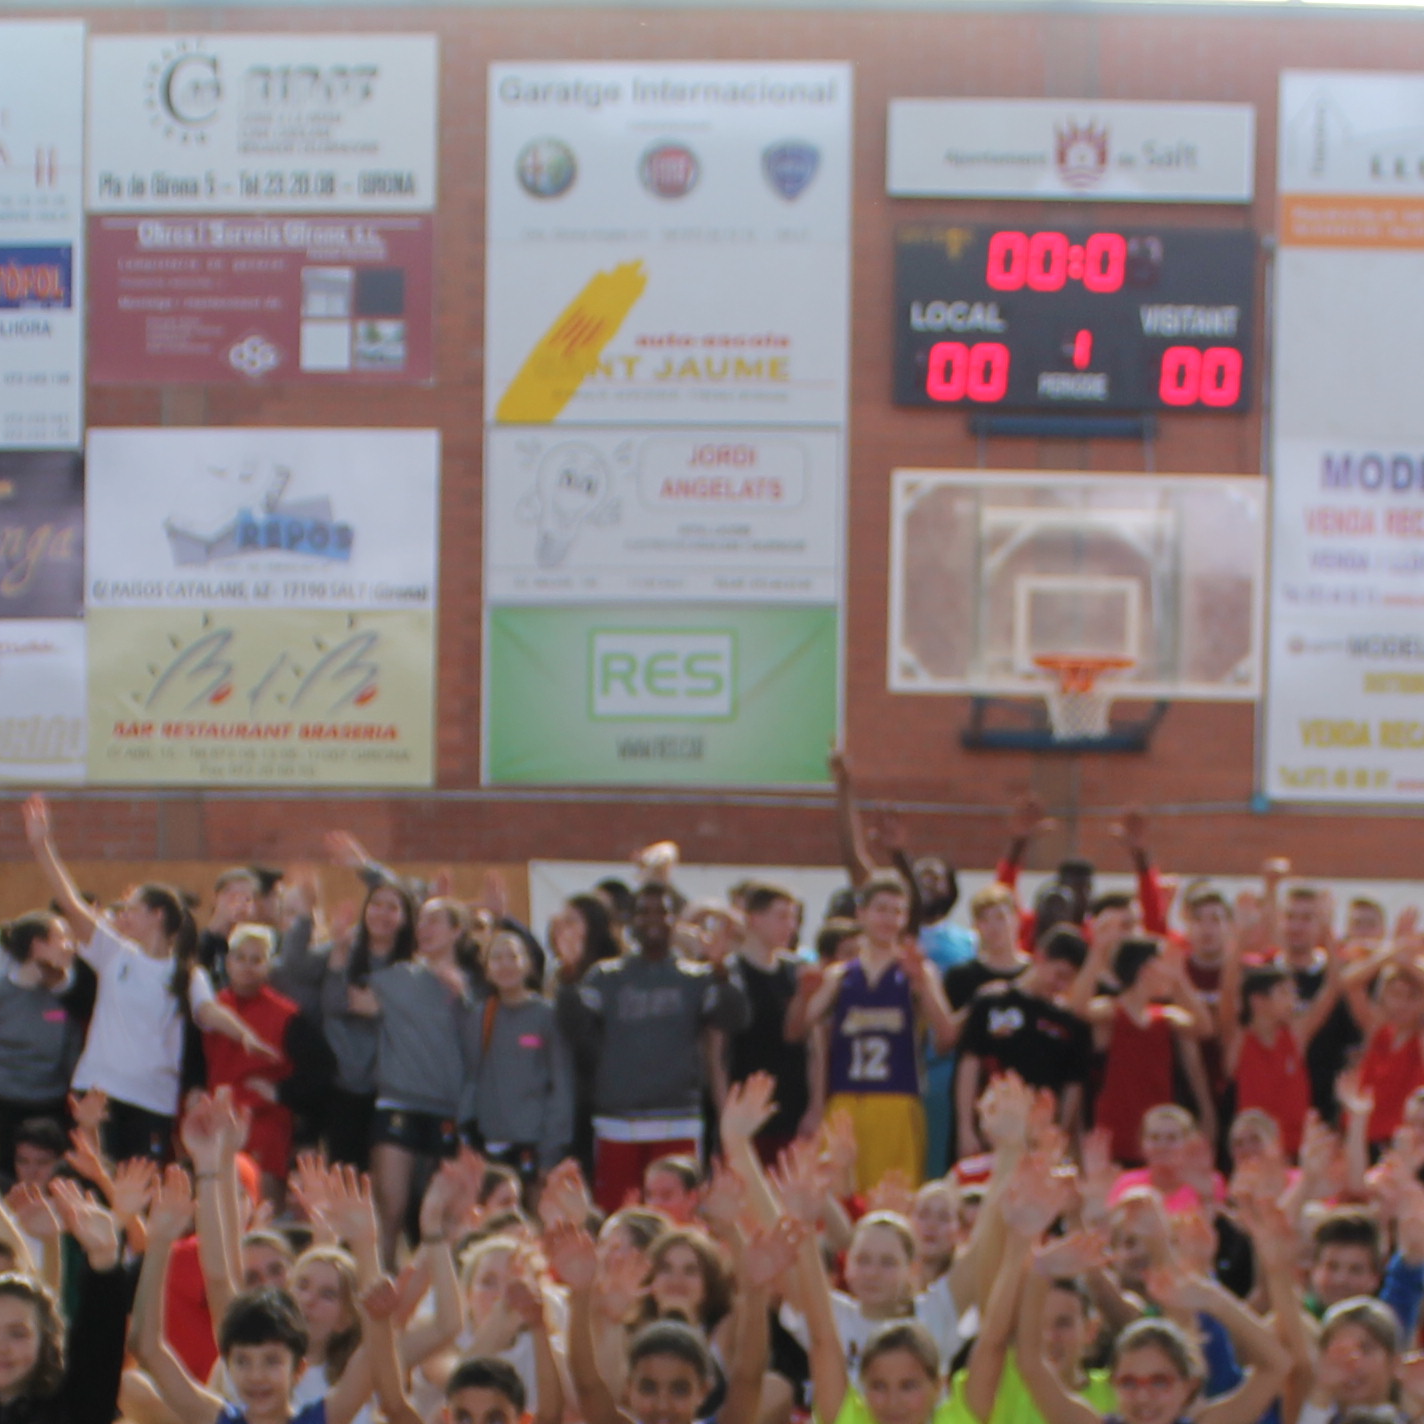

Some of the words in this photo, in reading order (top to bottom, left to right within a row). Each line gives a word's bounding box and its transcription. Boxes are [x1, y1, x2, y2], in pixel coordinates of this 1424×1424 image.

[498, 75, 622, 108] Garatge
[632, 75, 838, 108] Internacional
[1143, 140, 1199, 170] Salt
[150, 170, 199, 198] Girona
[911, 301, 1006, 333] LOCAL
[1141, 304, 1240, 336] VISITANT
[1072, 329, 1092, 370] 1
[654, 354, 792, 383] JAUME
[926, 341, 1010, 402] 00
[1159, 346, 1243, 407] 00
[686, 444, 759, 467] JORDI
[660, 477, 784, 502] ANGELATS
[237, 520, 355, 552] REPOS
[600, 652, 725, 698] RES
[113, 721, 154, 739] BAR
[161, 721, 293, 741] RESTAURANT
[299, 723, 399, 741] BRASERIA
[849, 1036, 890, 1081] 12
